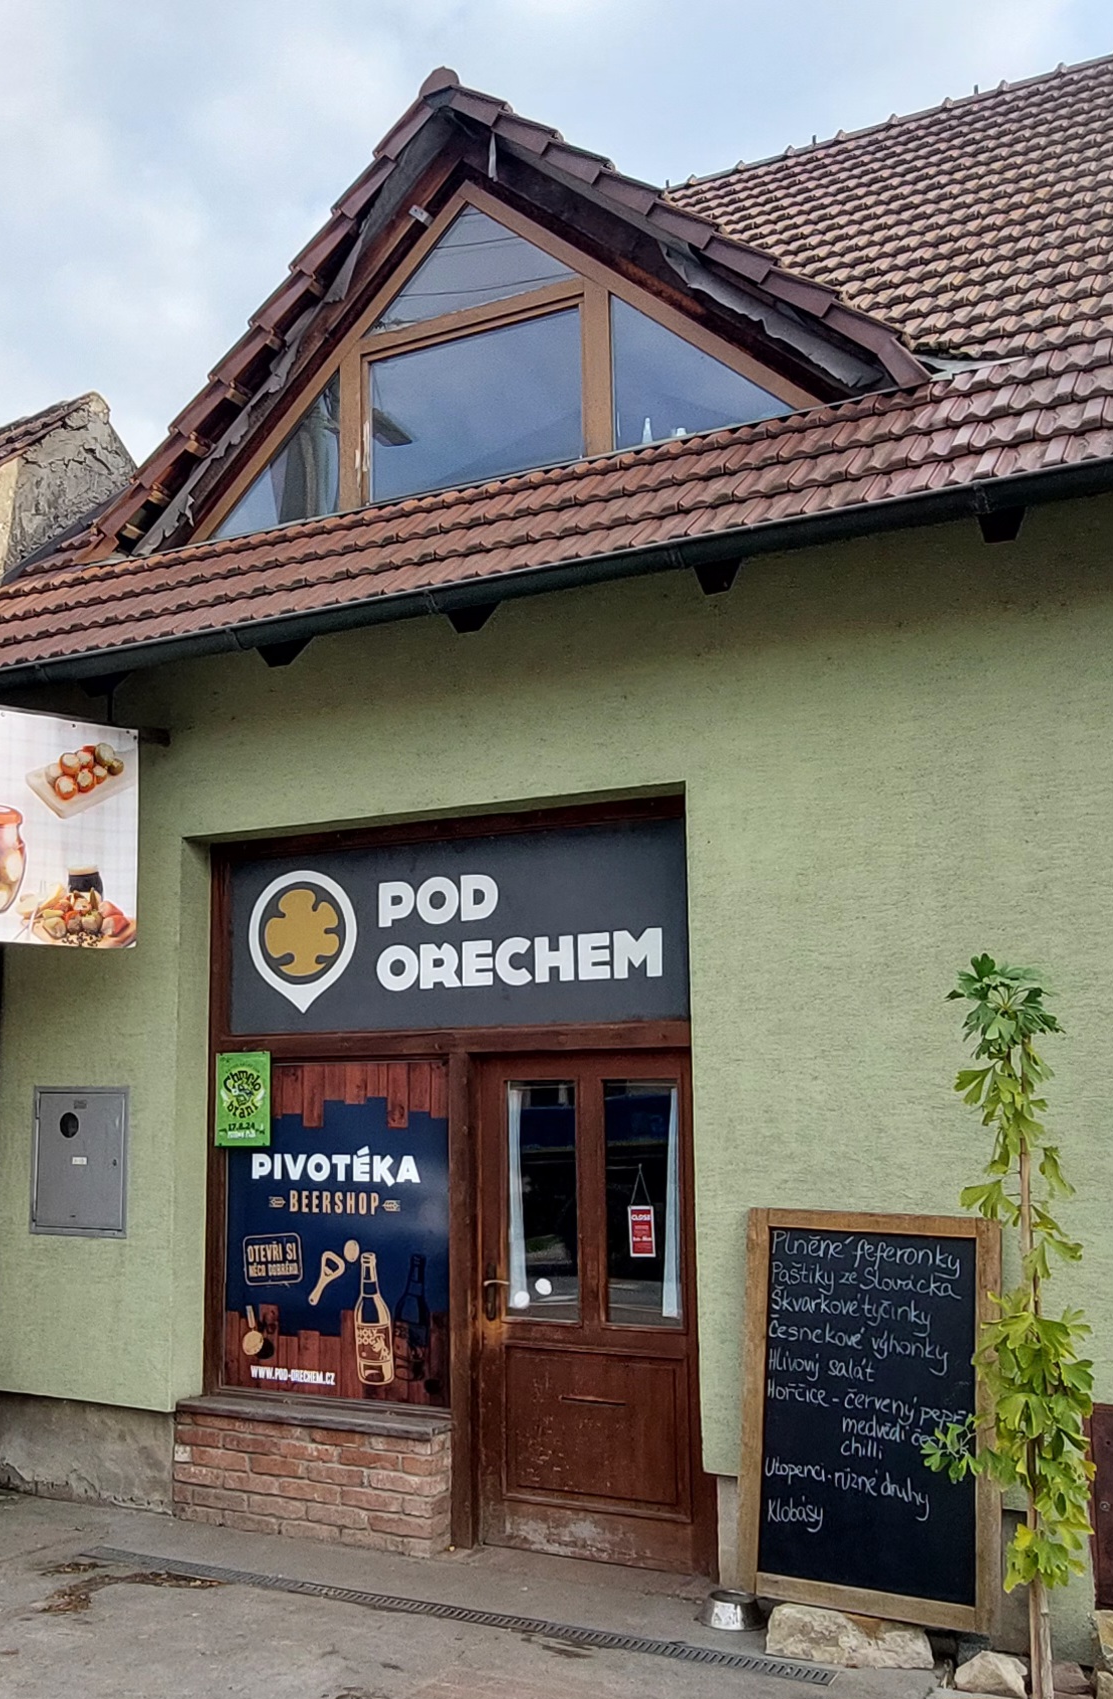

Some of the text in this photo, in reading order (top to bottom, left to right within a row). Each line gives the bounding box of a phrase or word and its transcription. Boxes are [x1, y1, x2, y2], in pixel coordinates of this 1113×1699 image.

[378, 874, 499, 928] POD
[252, 1146, 421, 1187] PIVOTÉKA
[289, 1190, 380, 1215] BEERSHOP
[247, 1241, 297, 1263] OTEVŘI SI
[772, 1230, 961, 1279] Plněné feferonky
[772, 1261, 962, 1299] Paštiky ze Slovácka
[771, 1284, 932, 1337] Škvarkové tyčinky
[827, 1358, 875, 1382] salát
[871, 1330, 949, 1376] výhonky
[767, 1378, 830, 1407] Hořčice
[844, 1388, 918, 1426] červený
[840, 1436, 883, 1460] chilli
[765, 1456, 826, 1485] Utopenci
[880, 1471, 930, 1522] druhy
[767, 1495, 824, 1533] Klobásy
